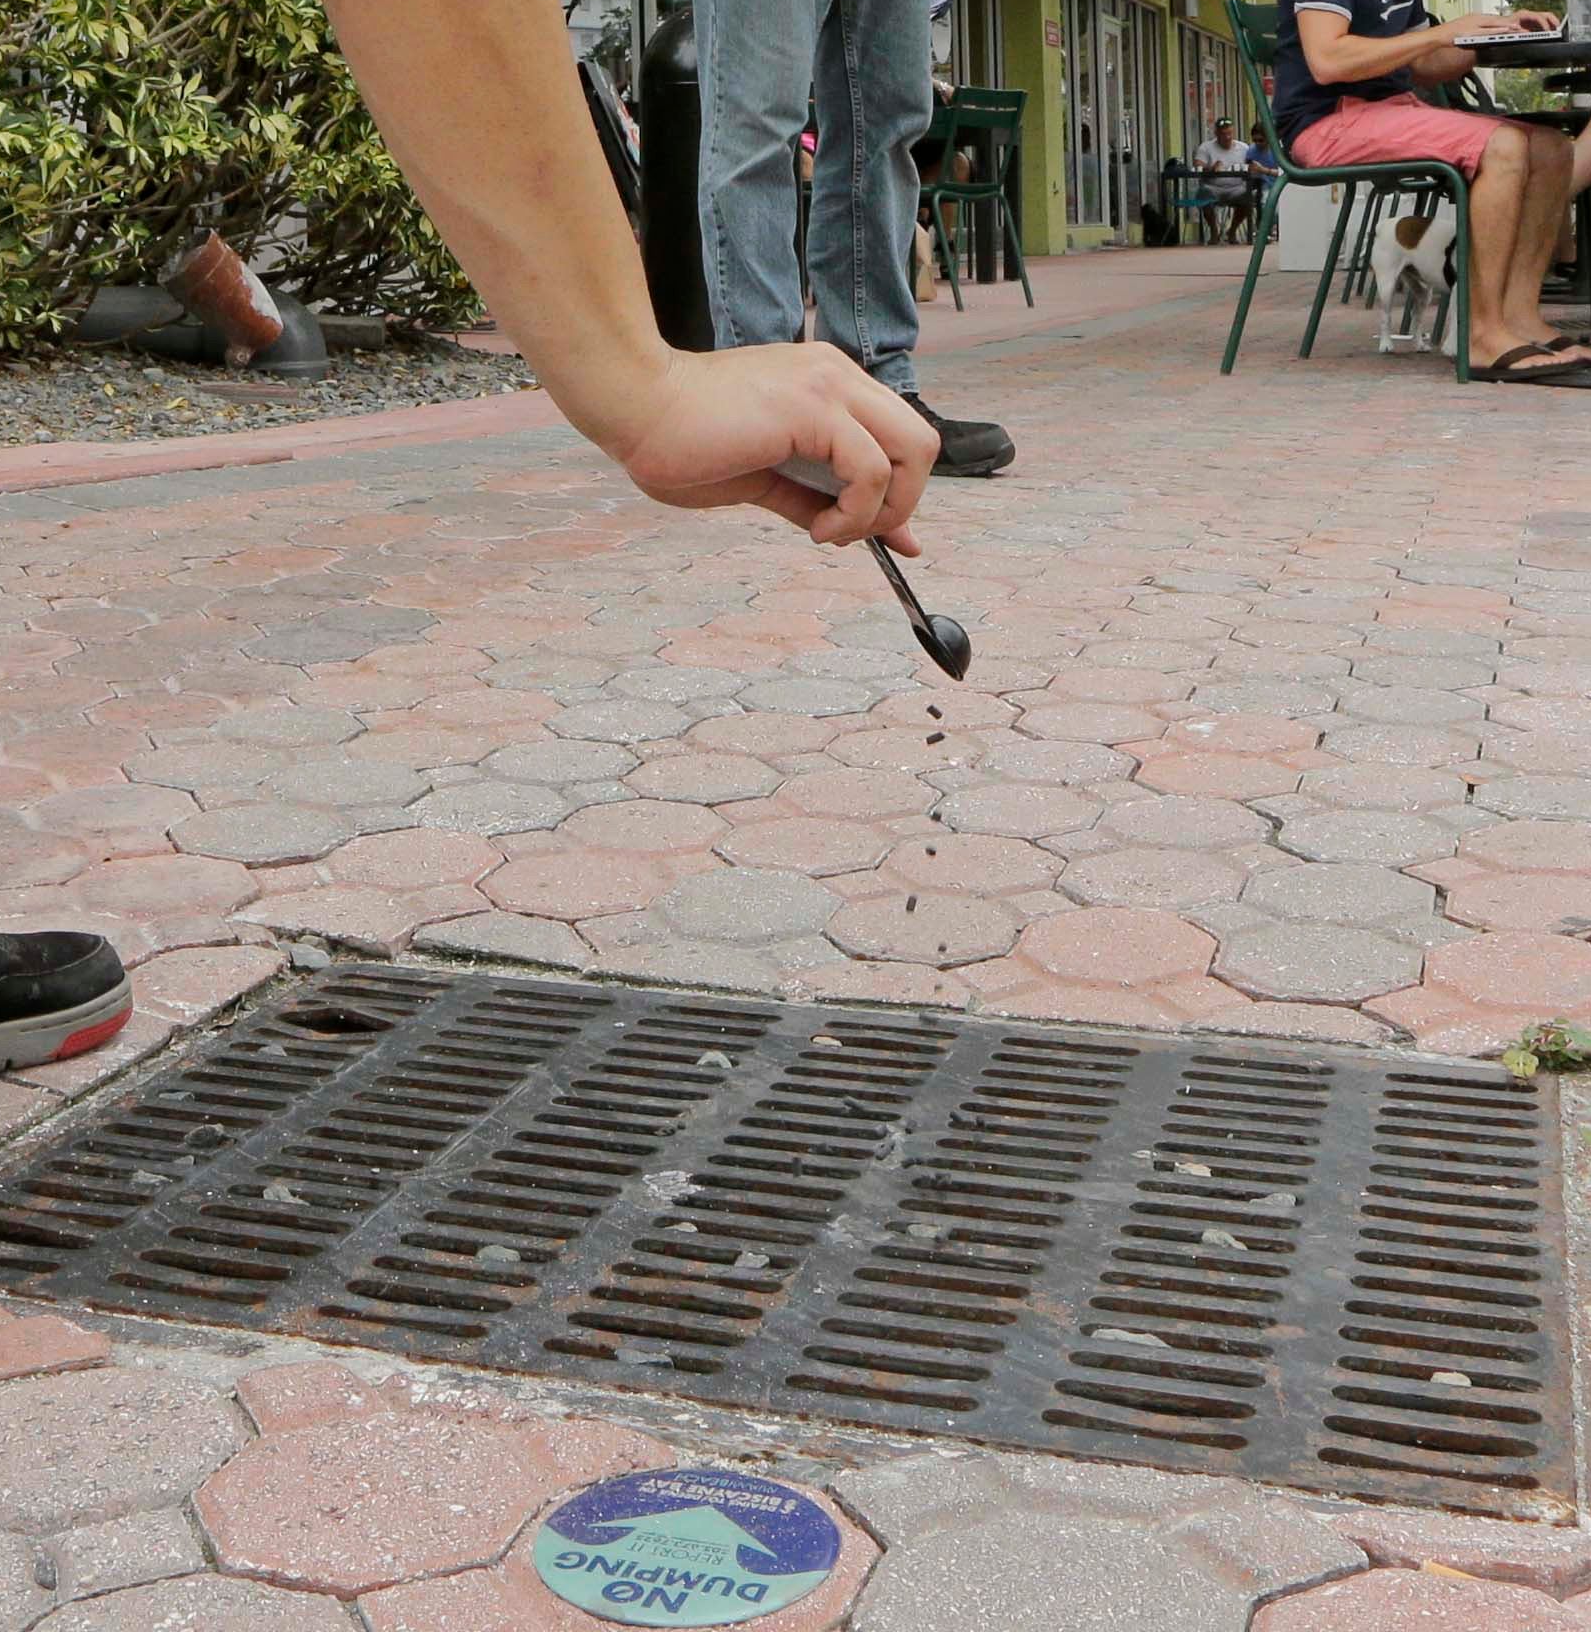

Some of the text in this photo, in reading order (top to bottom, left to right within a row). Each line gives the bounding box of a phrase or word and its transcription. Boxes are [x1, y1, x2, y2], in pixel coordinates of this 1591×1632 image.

[640, 1478, 783, 1506] BISCAYNE BAY
[627, 1540, 725, 1567] REPORT IT
[552, 1550, 771, 1604] DUMPING
[601, 1580, 690, 1615] NO
